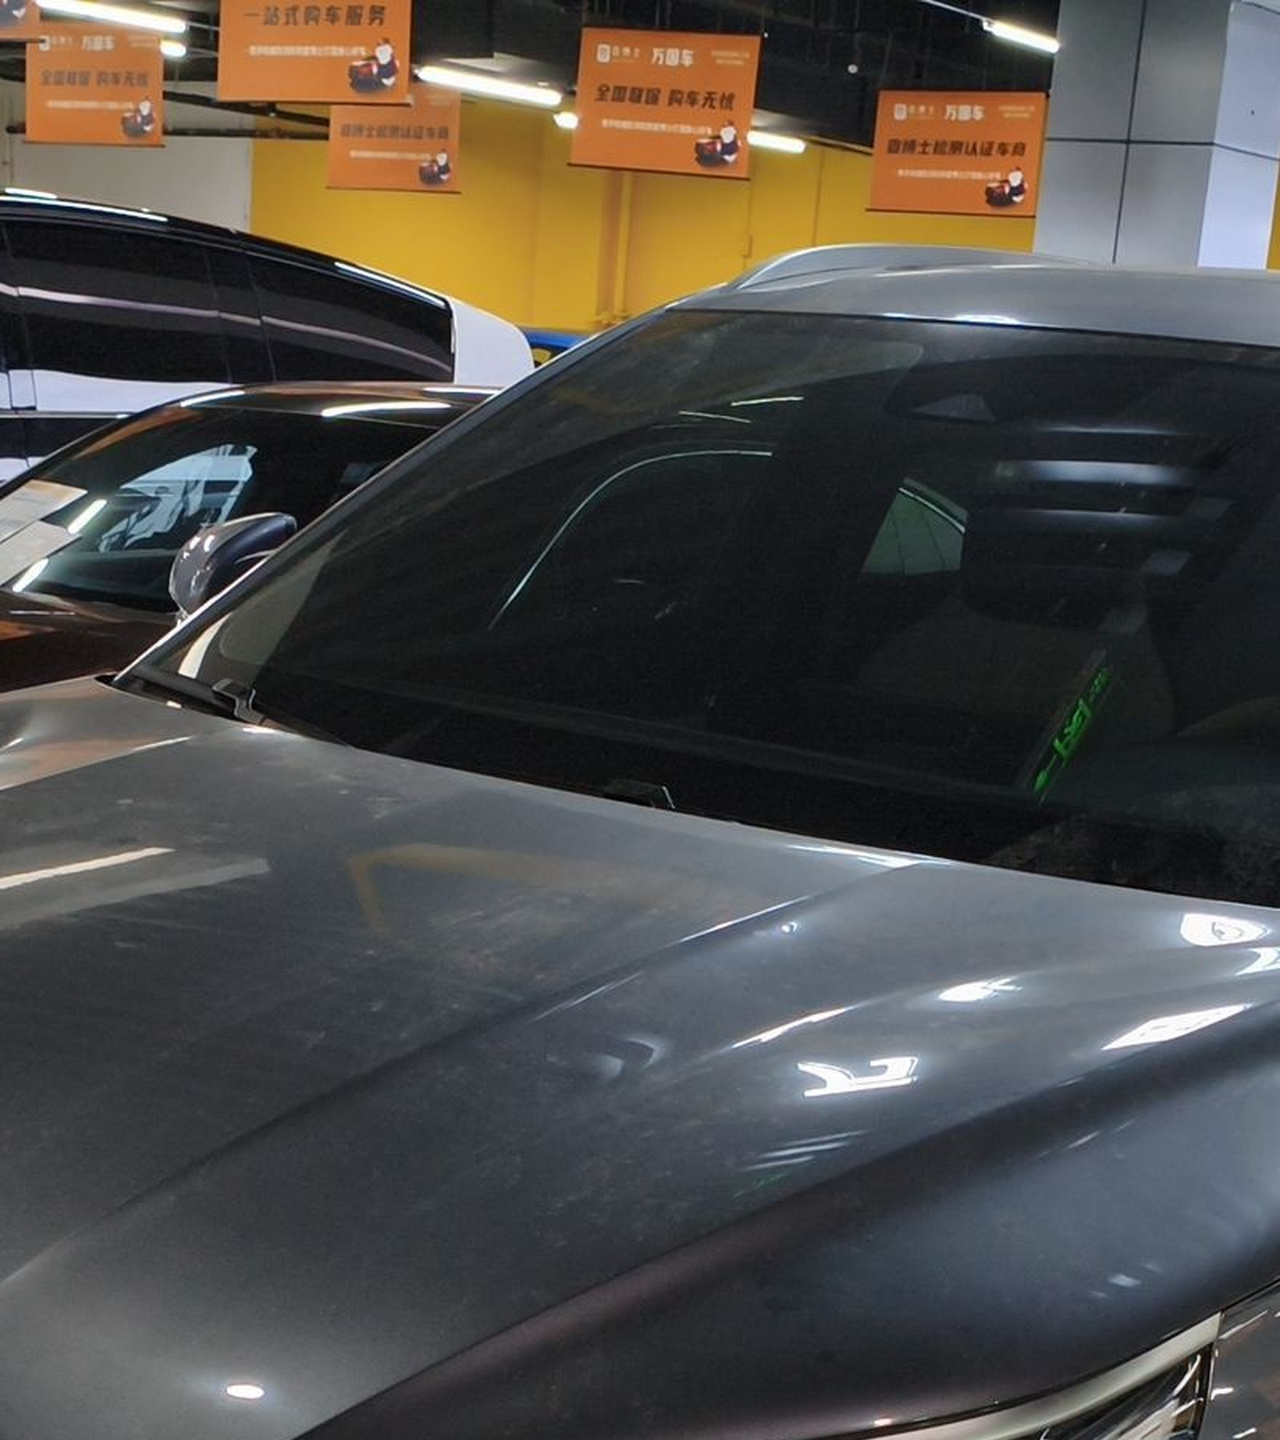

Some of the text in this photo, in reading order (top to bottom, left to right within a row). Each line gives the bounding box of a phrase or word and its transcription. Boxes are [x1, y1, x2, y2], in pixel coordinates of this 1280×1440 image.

[243, 5, 386, 26] 一站式购车服务
